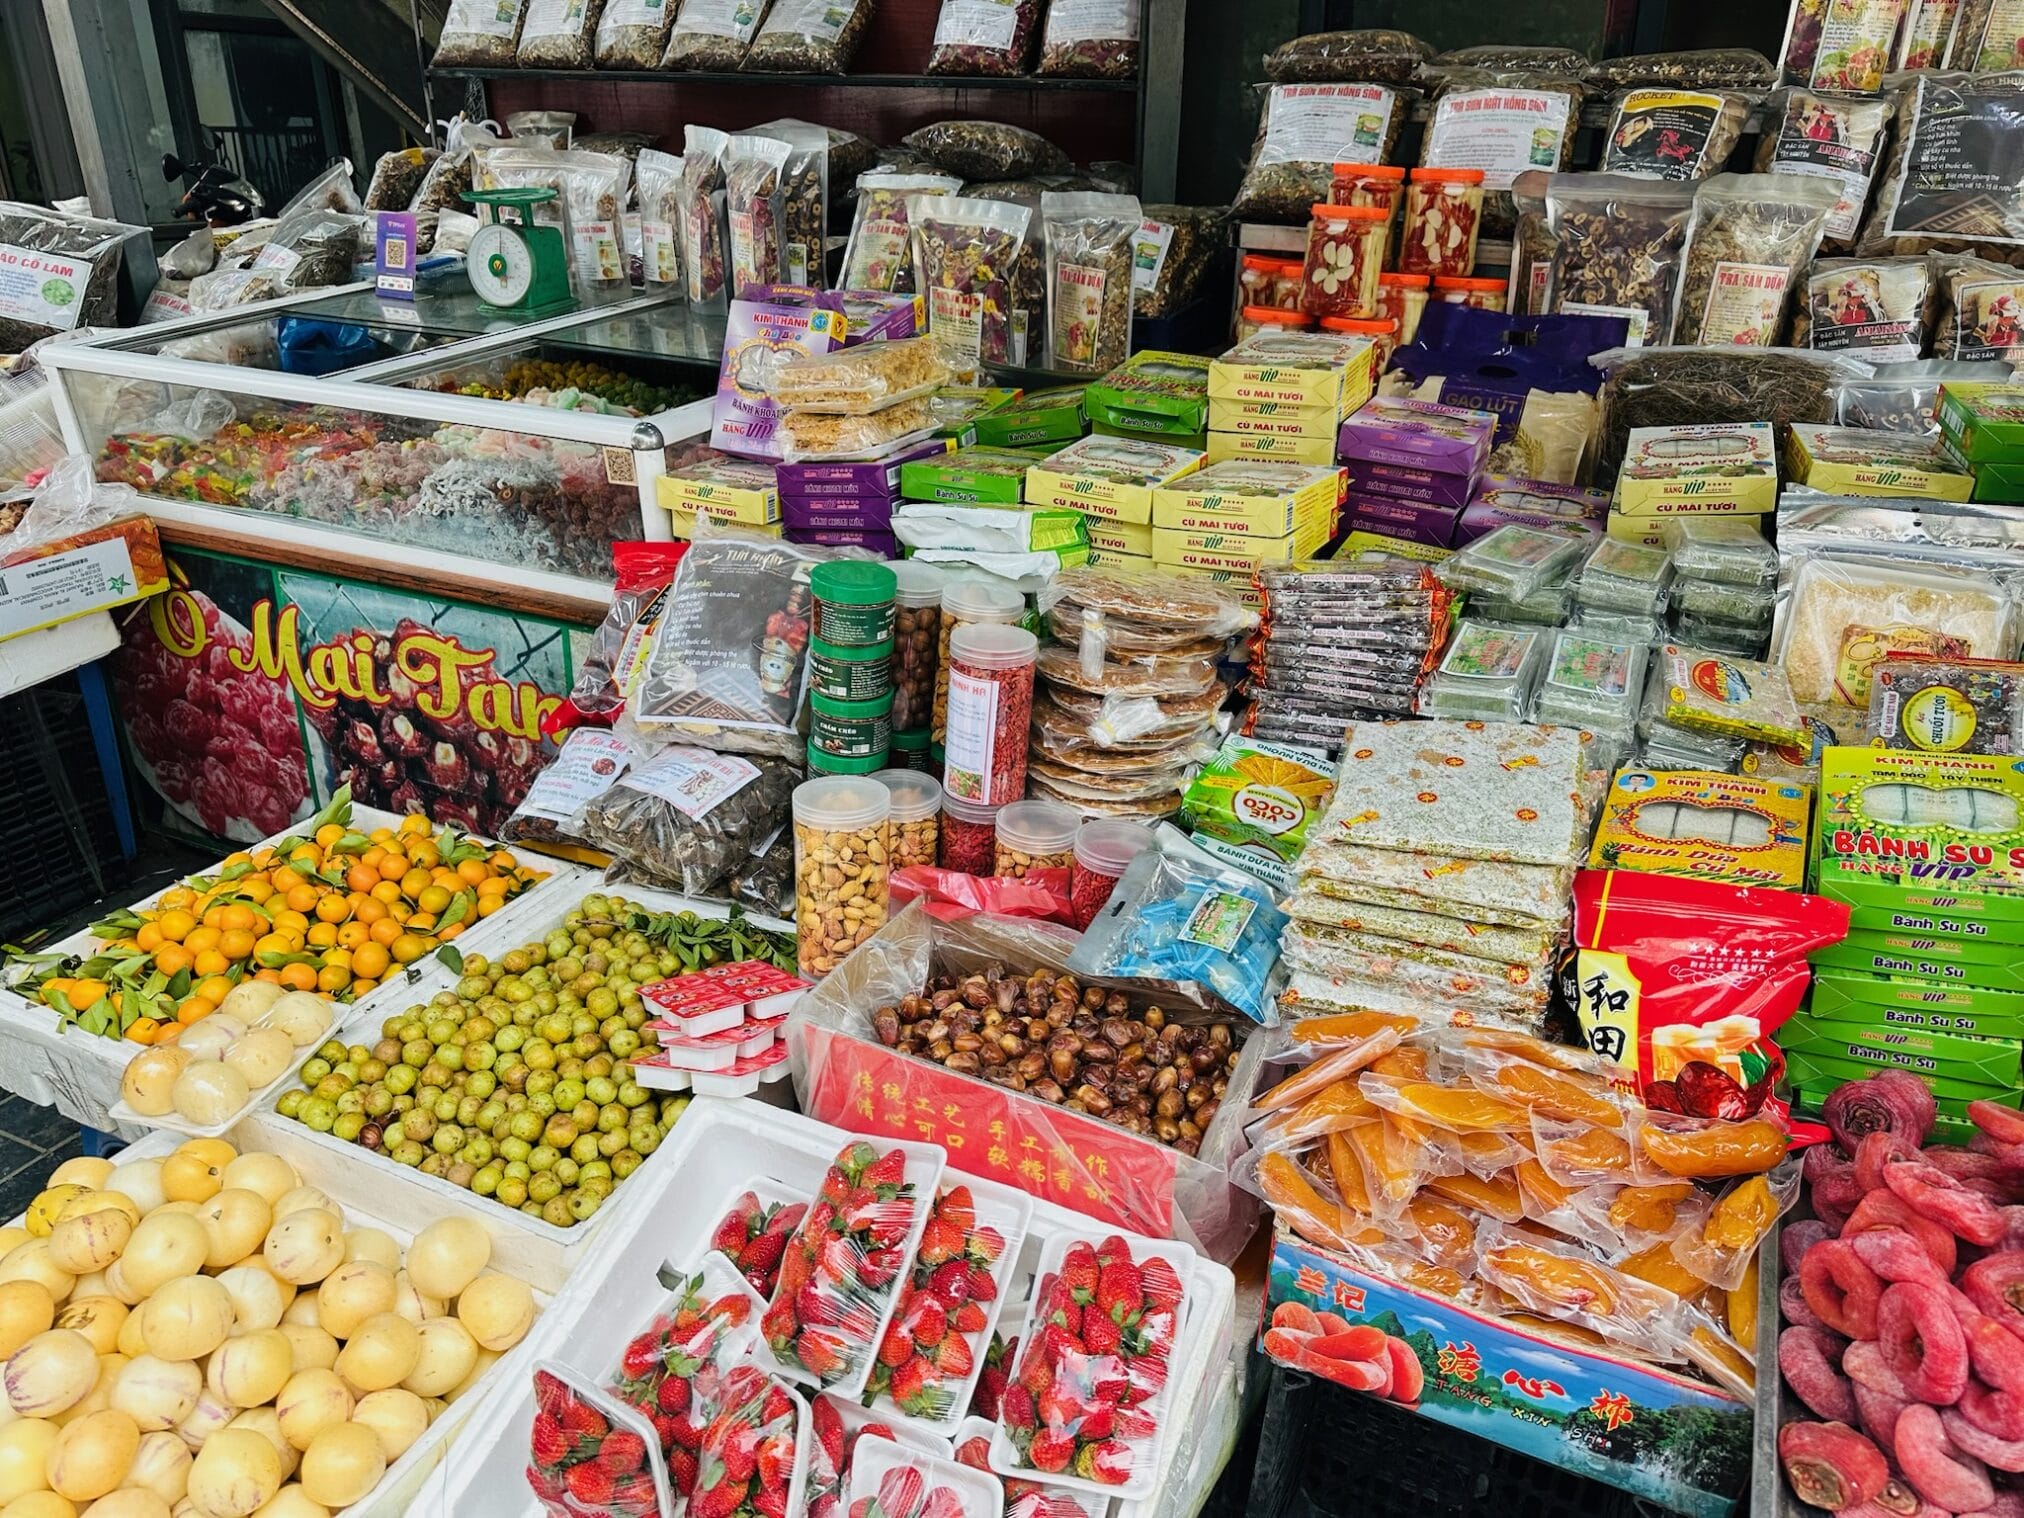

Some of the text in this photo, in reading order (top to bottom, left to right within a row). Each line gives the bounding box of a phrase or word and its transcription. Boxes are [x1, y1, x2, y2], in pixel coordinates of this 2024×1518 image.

[1629, 92, 1677, 103] ROCKET
[44, 263, 73, 277] LAM
[753, 313, 773, 323] KIM
[1706, 503, 1737, 511] TƯƠI
[1222, 520, 1250, 532] TƯƠI
[227, 598, 392, 710] Mai
[1874, 757, 1914, 765] KIM
[1667, 778, 1701, 787] KIM
[1243, 797, 1296, 821] COCO
[1615, 842, 1680, 858] Bánh
[1833, 829, 1930, 860] BÁNH
[1944, 844, 1993, 866] SU
[1840, 861, 1905, 875] HÀNG
[1893, 915, 1987, 936] Bánh Su Su
[1873, 956, 1965, 978] Bánh Su Su
[1582, 969, 1631, 1063] 和田
[1885, 1010, 1975, 1030] Bánh Su Su
[1848, 1044, 1936, 1070] Bánh Su Su
[1294, 1265, 1368, 1314] 兰记
[1436, 1378, 1492, 1409] TANG
[1511, 1406, 1551, 1427] XIN
